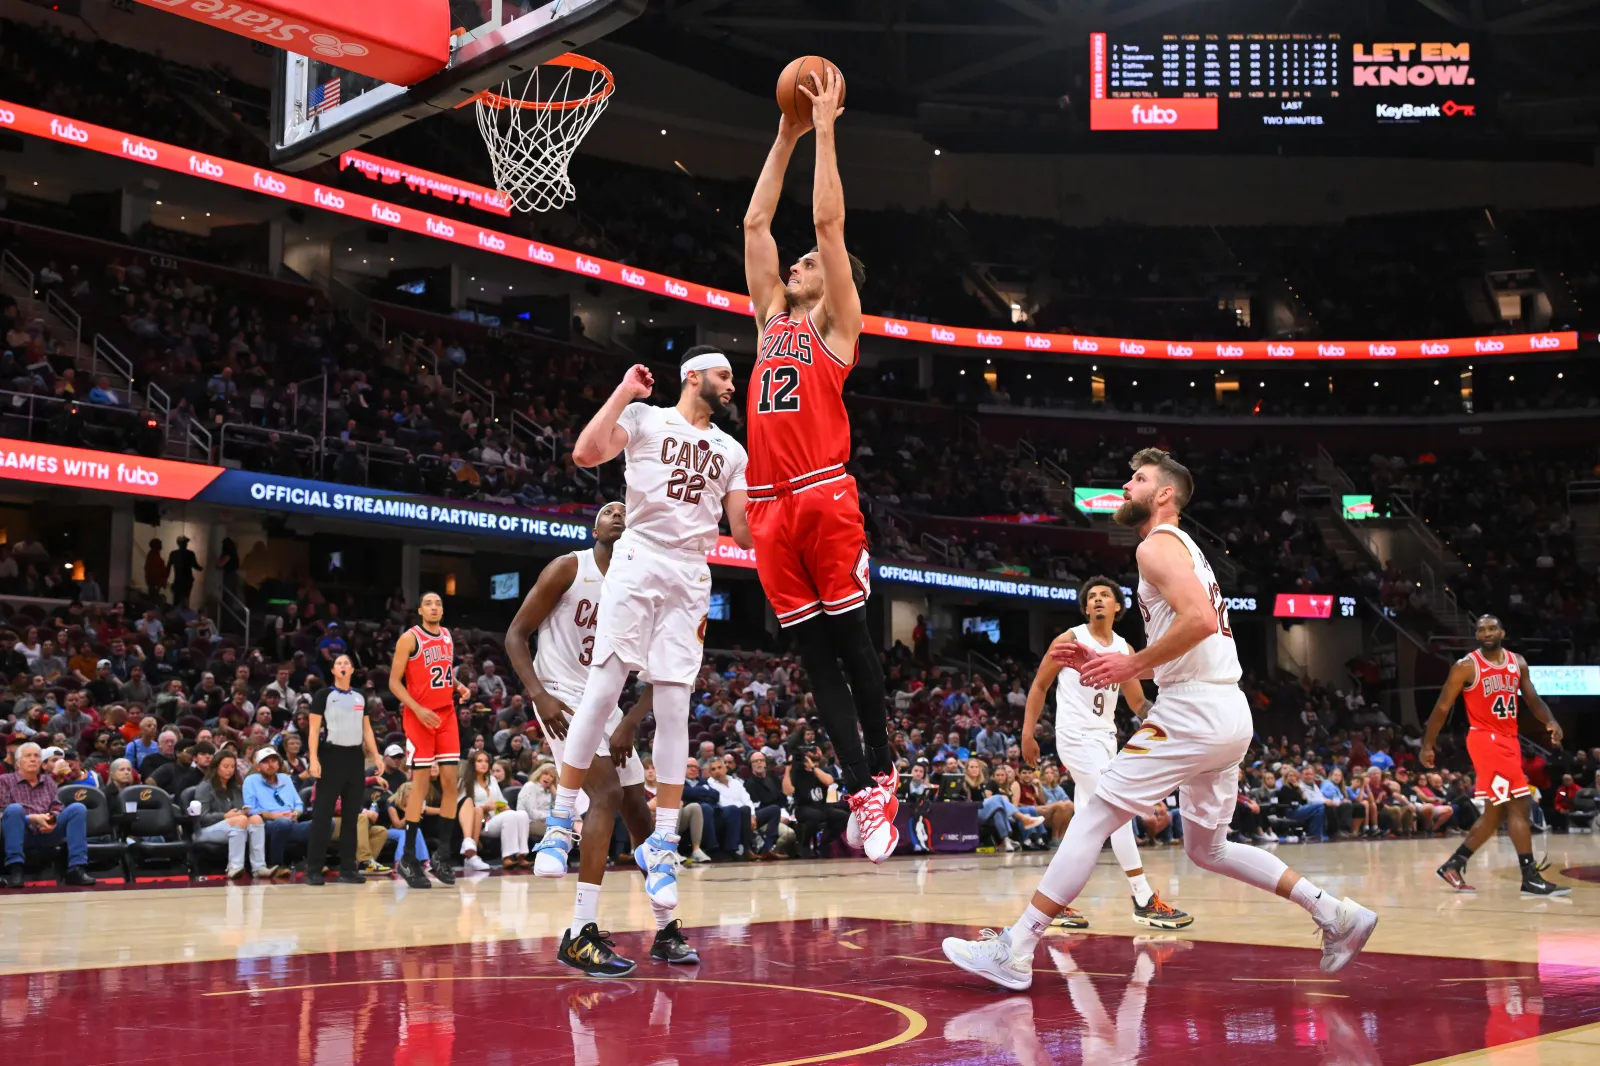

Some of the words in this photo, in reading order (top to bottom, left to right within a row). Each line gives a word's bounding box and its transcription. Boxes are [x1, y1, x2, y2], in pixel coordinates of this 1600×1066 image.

[190, 0, 310, 41] State
[1122, 44, 1140, 53] Terry
[1353, 43, 1416, 62] LET
[1421, 42, 1470, 62] EM
[1353, 65, 1475, 86] KNOW.
[1131, 105, 1178, 124] fubo
[1281, 101, 1303, 110] LAST
[1376, 104, 1440, 119] KeyBank
[1263, 116, 1283, 125] TWO
[50, 119, 89, 143] fubo
[122, 138, 158, 161] fubo
[189, 156, 225, 178] fubo
[253, 172, 287, 195] fubo
[381, 166, 401, 178] LIVE
[426, 180, 458, 195] GAMES
[459, 188, 482, 202] WITH
[314, 188, 346, 210] fubo
[372, 203, 402, 224] fubo
[426, 218, 456, 238] fubo
[478, 232, 507, 251] fubo
[528, 244, 555, 264] fubo
[576, 257, 601, 275] fubo
[622, 269, 646, 287] fubo
[665, 280, 689, 298] fubo
[706, 291, 730, 308] fubo
[884, 320, 909, 337] fubo
[931, 326, 956, 343] fubo
[977, 331, 1004, 346] fubo
[1025, 334, 1052, 349] fubo
[1073, 337, 1099, 352] fubo
[1120, 340, 1146, 355] fubo
[1475, 339, 1505, 353] fubo
[1530, 335, 1561, 349] fubo
[1167, 343, 1194, 357] fubo
[1216, 344, 1244, 357] fubo
[1267, 343, 1295, 357] fubo
[1318, 343, 1346, 357] fubo
[1369, 343, 1397, 357] fubo
[1421, 342, 1450, 355] fubo
[757, 365, 800, 414] 12
[660, 437, 725, 480] CAVS
[64, 459, 109, 480] WITH
[117, 463, 159, 486] fubo
[666, 469, 706, 505] 22
[251, 483, 331, 508] OFFICIAL
[333, 493, 429, 520] STREAMING
[431, 506, 497, 529] PARTNER
[498, 515, 519, 531] OF
[520, 518, 548, 535] THE
[549, 522, 587, 540] CAVS
[719, 545, 748, 560] CAVS
[879, 565, 924, 583] OFFICIAL
[925, 572, 978, 590] STREAMING
[979, 578, 1017, 595] PARTNER
[1018, 583, 1030, 596] OF
[1030, 585, 1050, 599] THE
[1050, 587, 1077, 601] CAVS
[1224, 597, 1257, 610] OCKS
[1286, 598, 1296, 614] 1
[1341, 606, 1354, 617] 51
[574, 599, 599, 630] CA
[430, 665, 453, 690] 24
[1532, 669, 1586, 679] OMCAST
[1092, 692, 1105, 717] 9
[1491, 694, 1517, 719] 44
